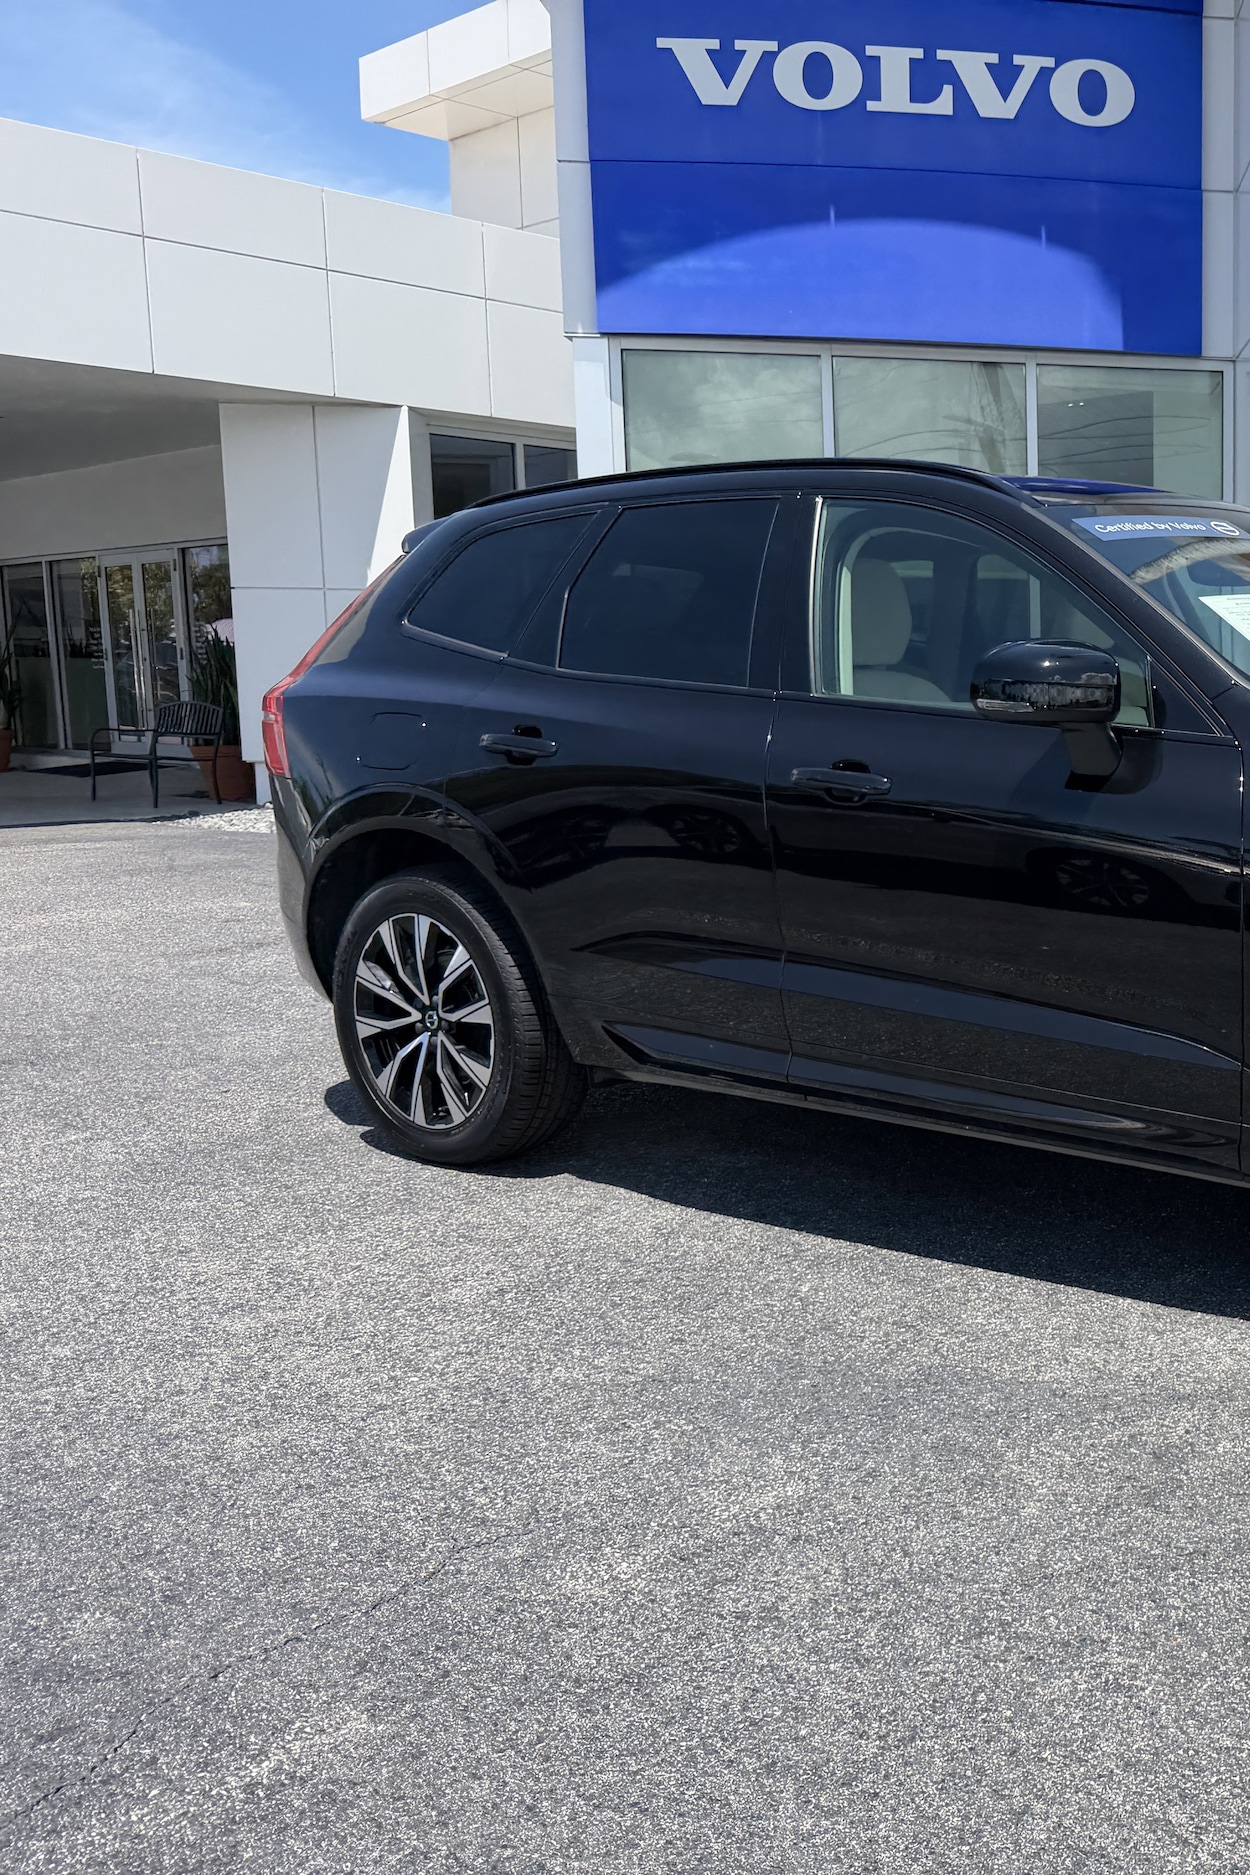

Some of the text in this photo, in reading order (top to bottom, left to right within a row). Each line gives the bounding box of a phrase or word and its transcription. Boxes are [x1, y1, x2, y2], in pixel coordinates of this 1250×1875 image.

[655, 37, 1136, 128] VOLVO
[1094, 521, 1207, 533] Certified by Volvo
